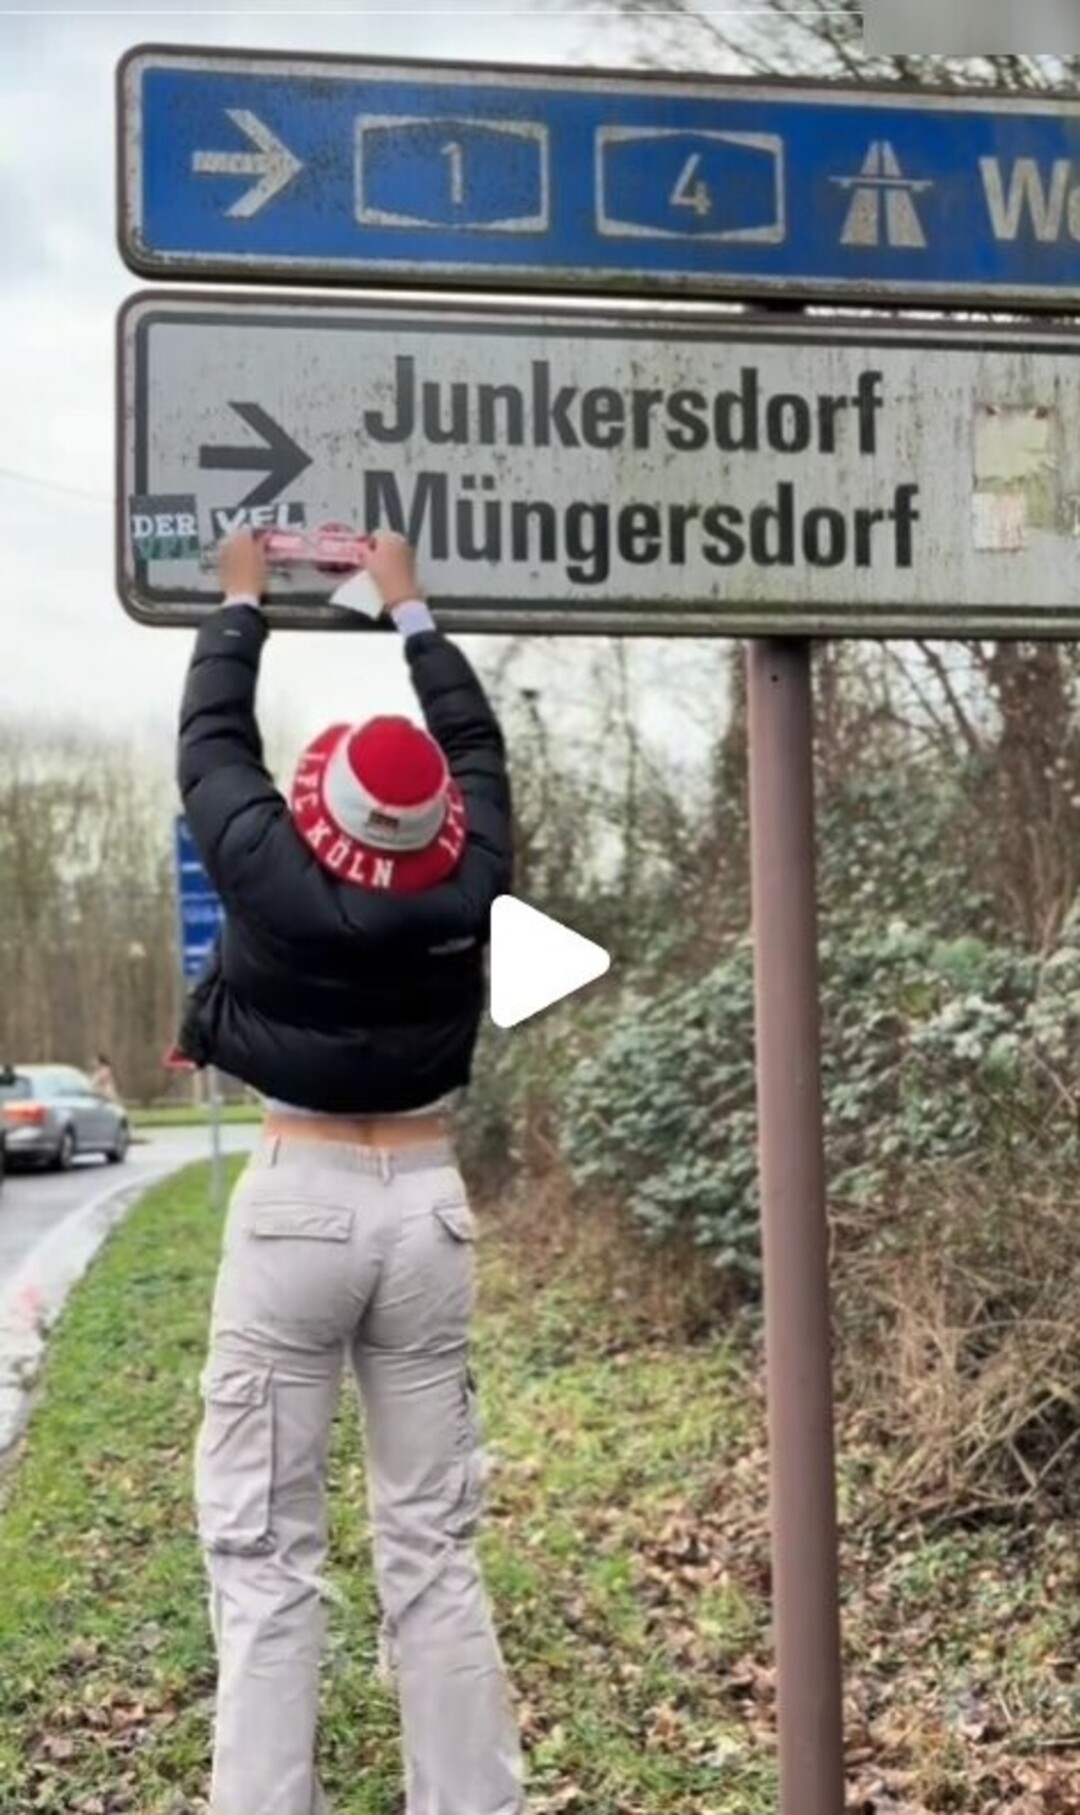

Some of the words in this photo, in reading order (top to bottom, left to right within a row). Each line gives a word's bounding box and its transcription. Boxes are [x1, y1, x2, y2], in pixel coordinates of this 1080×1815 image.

[441, 141, 465, 204] 1
[669, 153, 712, 216] 4
[979, 157, 1080, 241] W
[363, 354, 883, 456] Junkersdorf
[132, 511, 198, 539] DER
[363, 469, 919, 584] Müngersdorf
